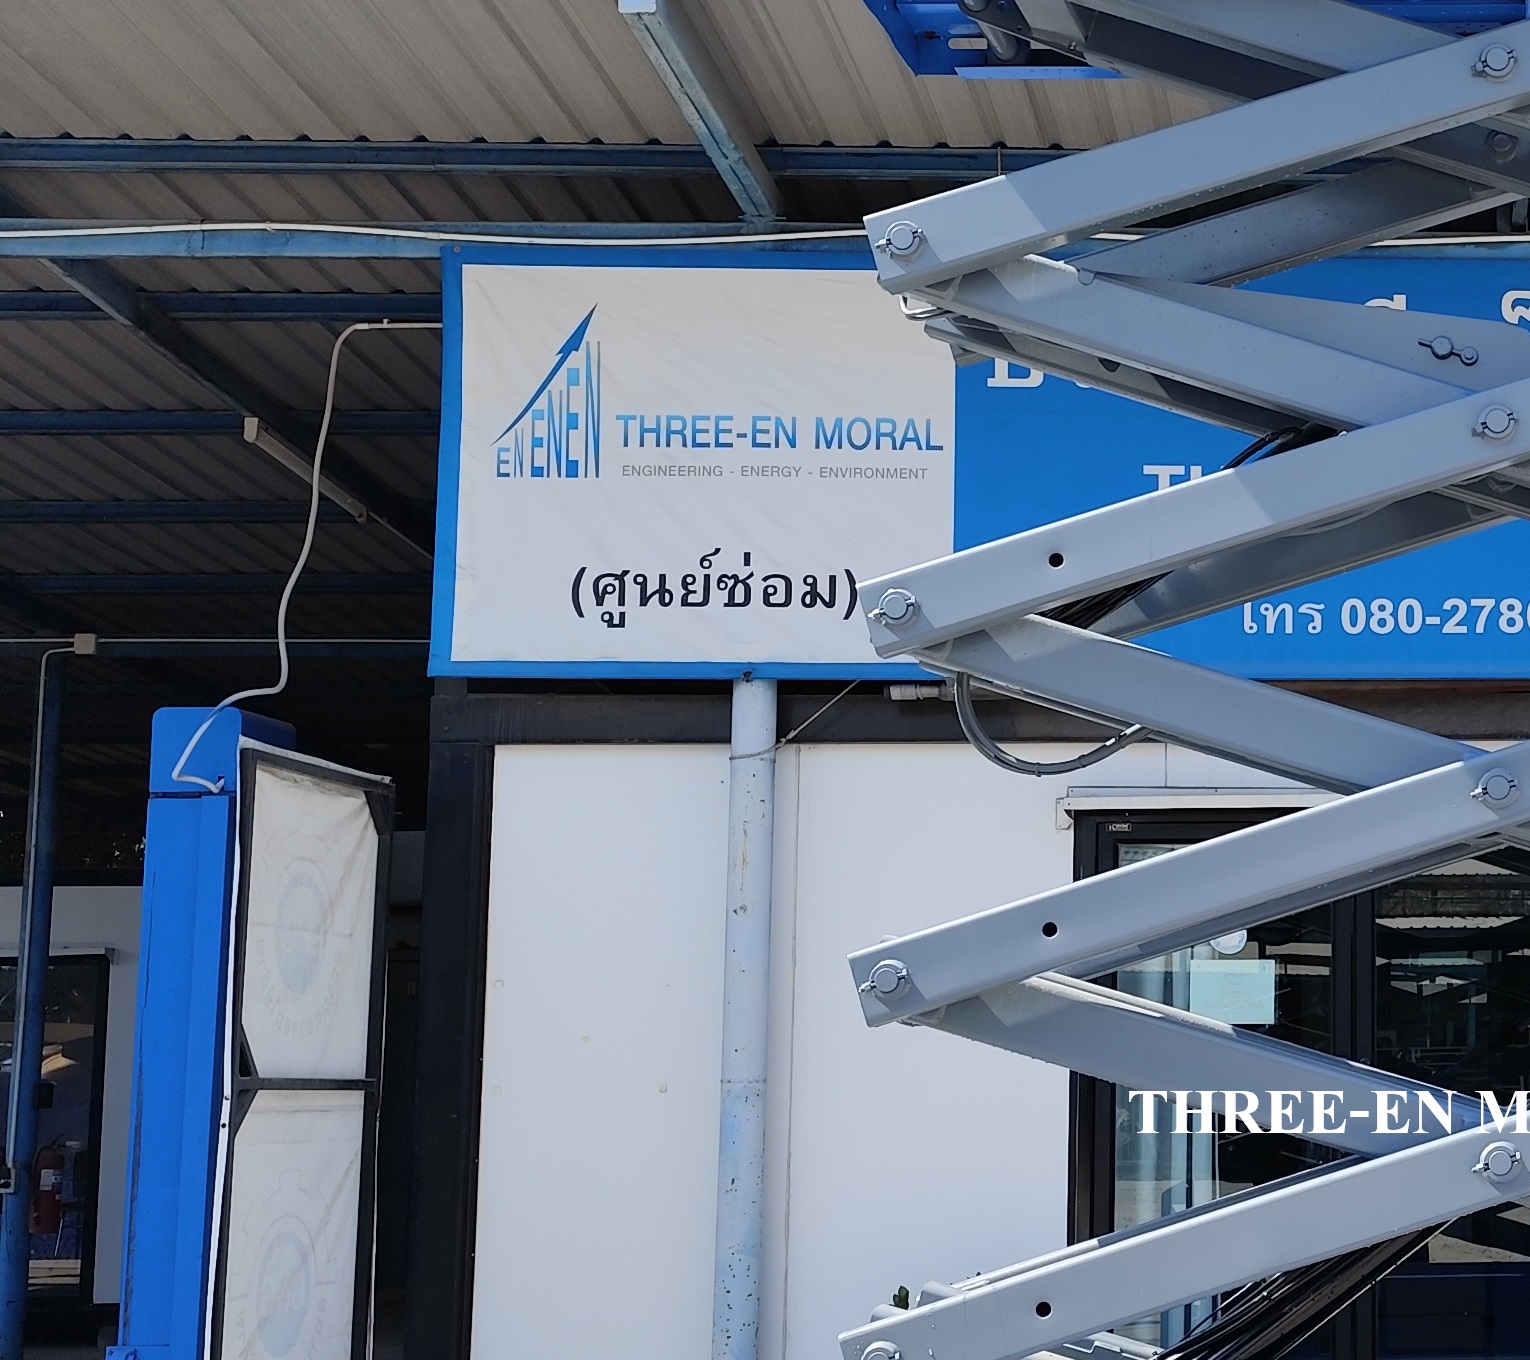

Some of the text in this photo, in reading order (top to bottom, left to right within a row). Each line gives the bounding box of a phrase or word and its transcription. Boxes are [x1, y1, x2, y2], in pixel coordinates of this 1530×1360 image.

[615, 414, 944, 451] THREE-EN MORAL
[622, 464, 723, 478] ENGINEERING
[740, 465, 802, 478] ENERGY
[819, 466, 929, 480] ENVIRONMENT
